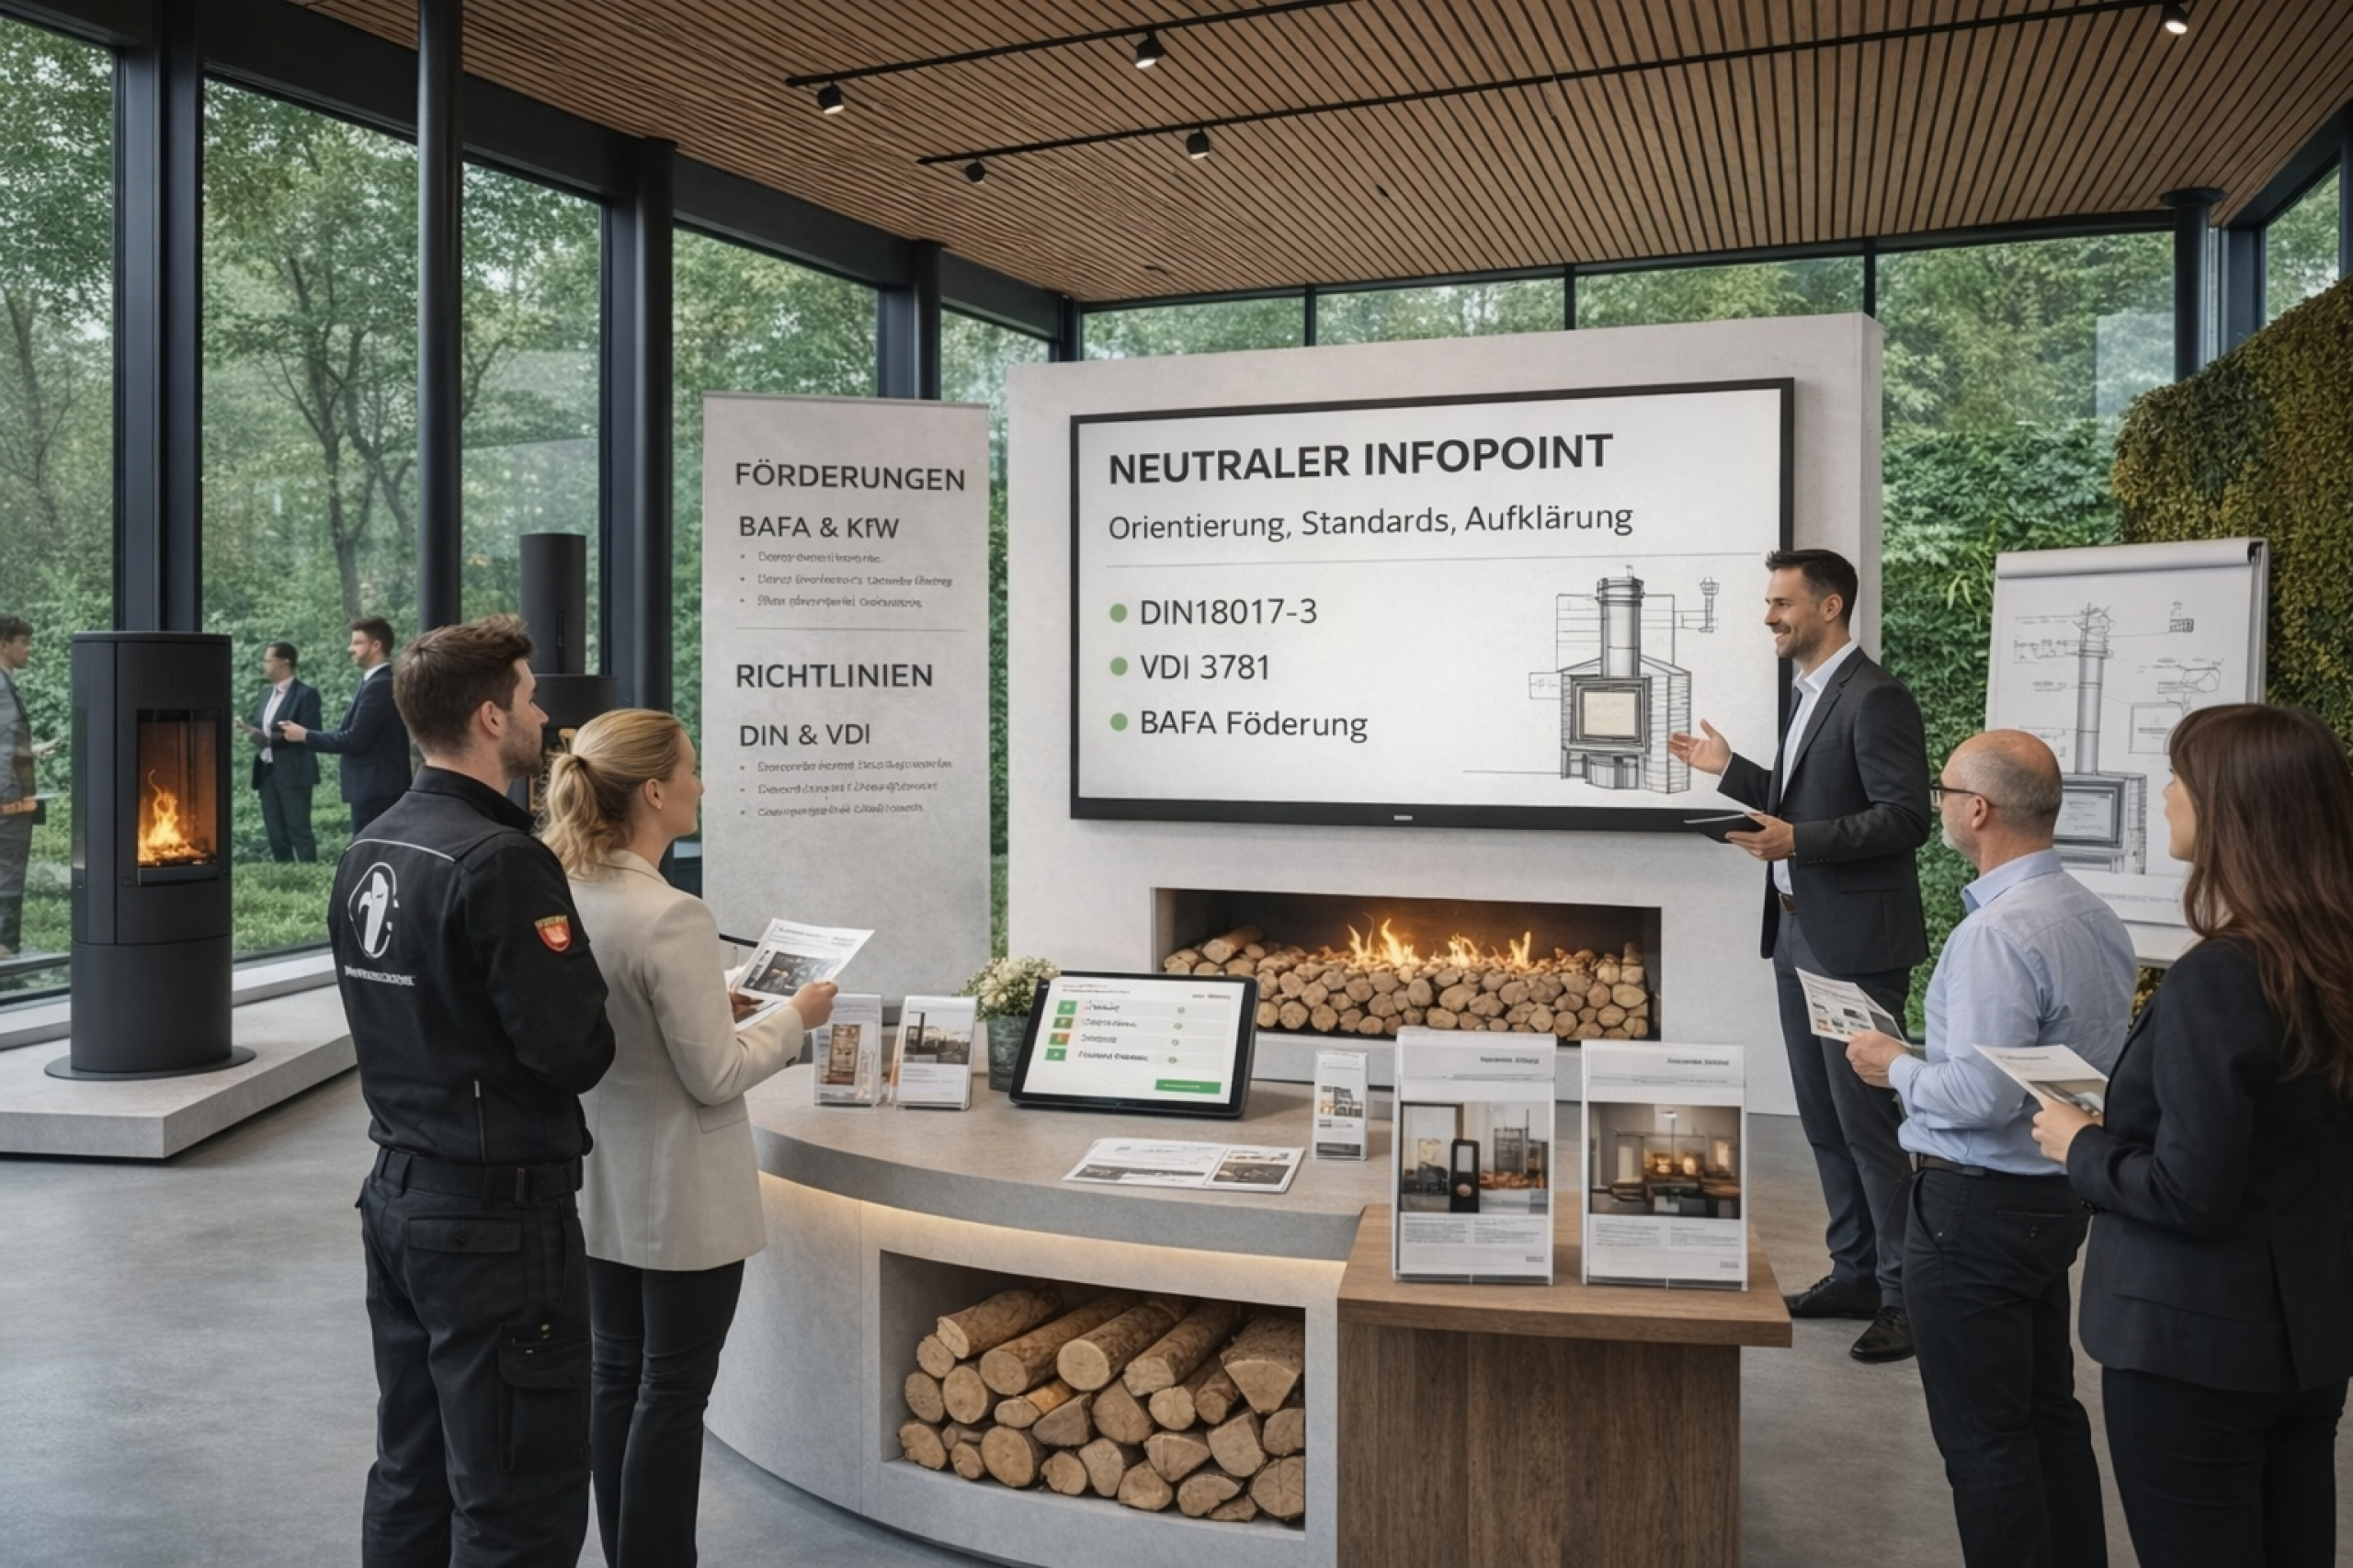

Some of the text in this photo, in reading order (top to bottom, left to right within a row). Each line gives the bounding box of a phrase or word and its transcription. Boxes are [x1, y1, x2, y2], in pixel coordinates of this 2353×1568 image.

[1109, 433, 1614, 484] NEUTRALER INFOPOINT
[735, 459, 965, 491] FÖRDERUNGEN
[739, 516, 900, 540] BAFA & KfW
[1108, 505, 1634, 543] Orientierung, Standards, Aufklärung
[1141, 597, 1317, 626] DIN18017-3
[736, 664, 933, 688] RICHTLINIEN
[1141, 654, 1268, 681] VDI 3781
[740, 723, 870, 747] DIN & VDI
[1141, 710, 1369, 743] BAFA Föderung
